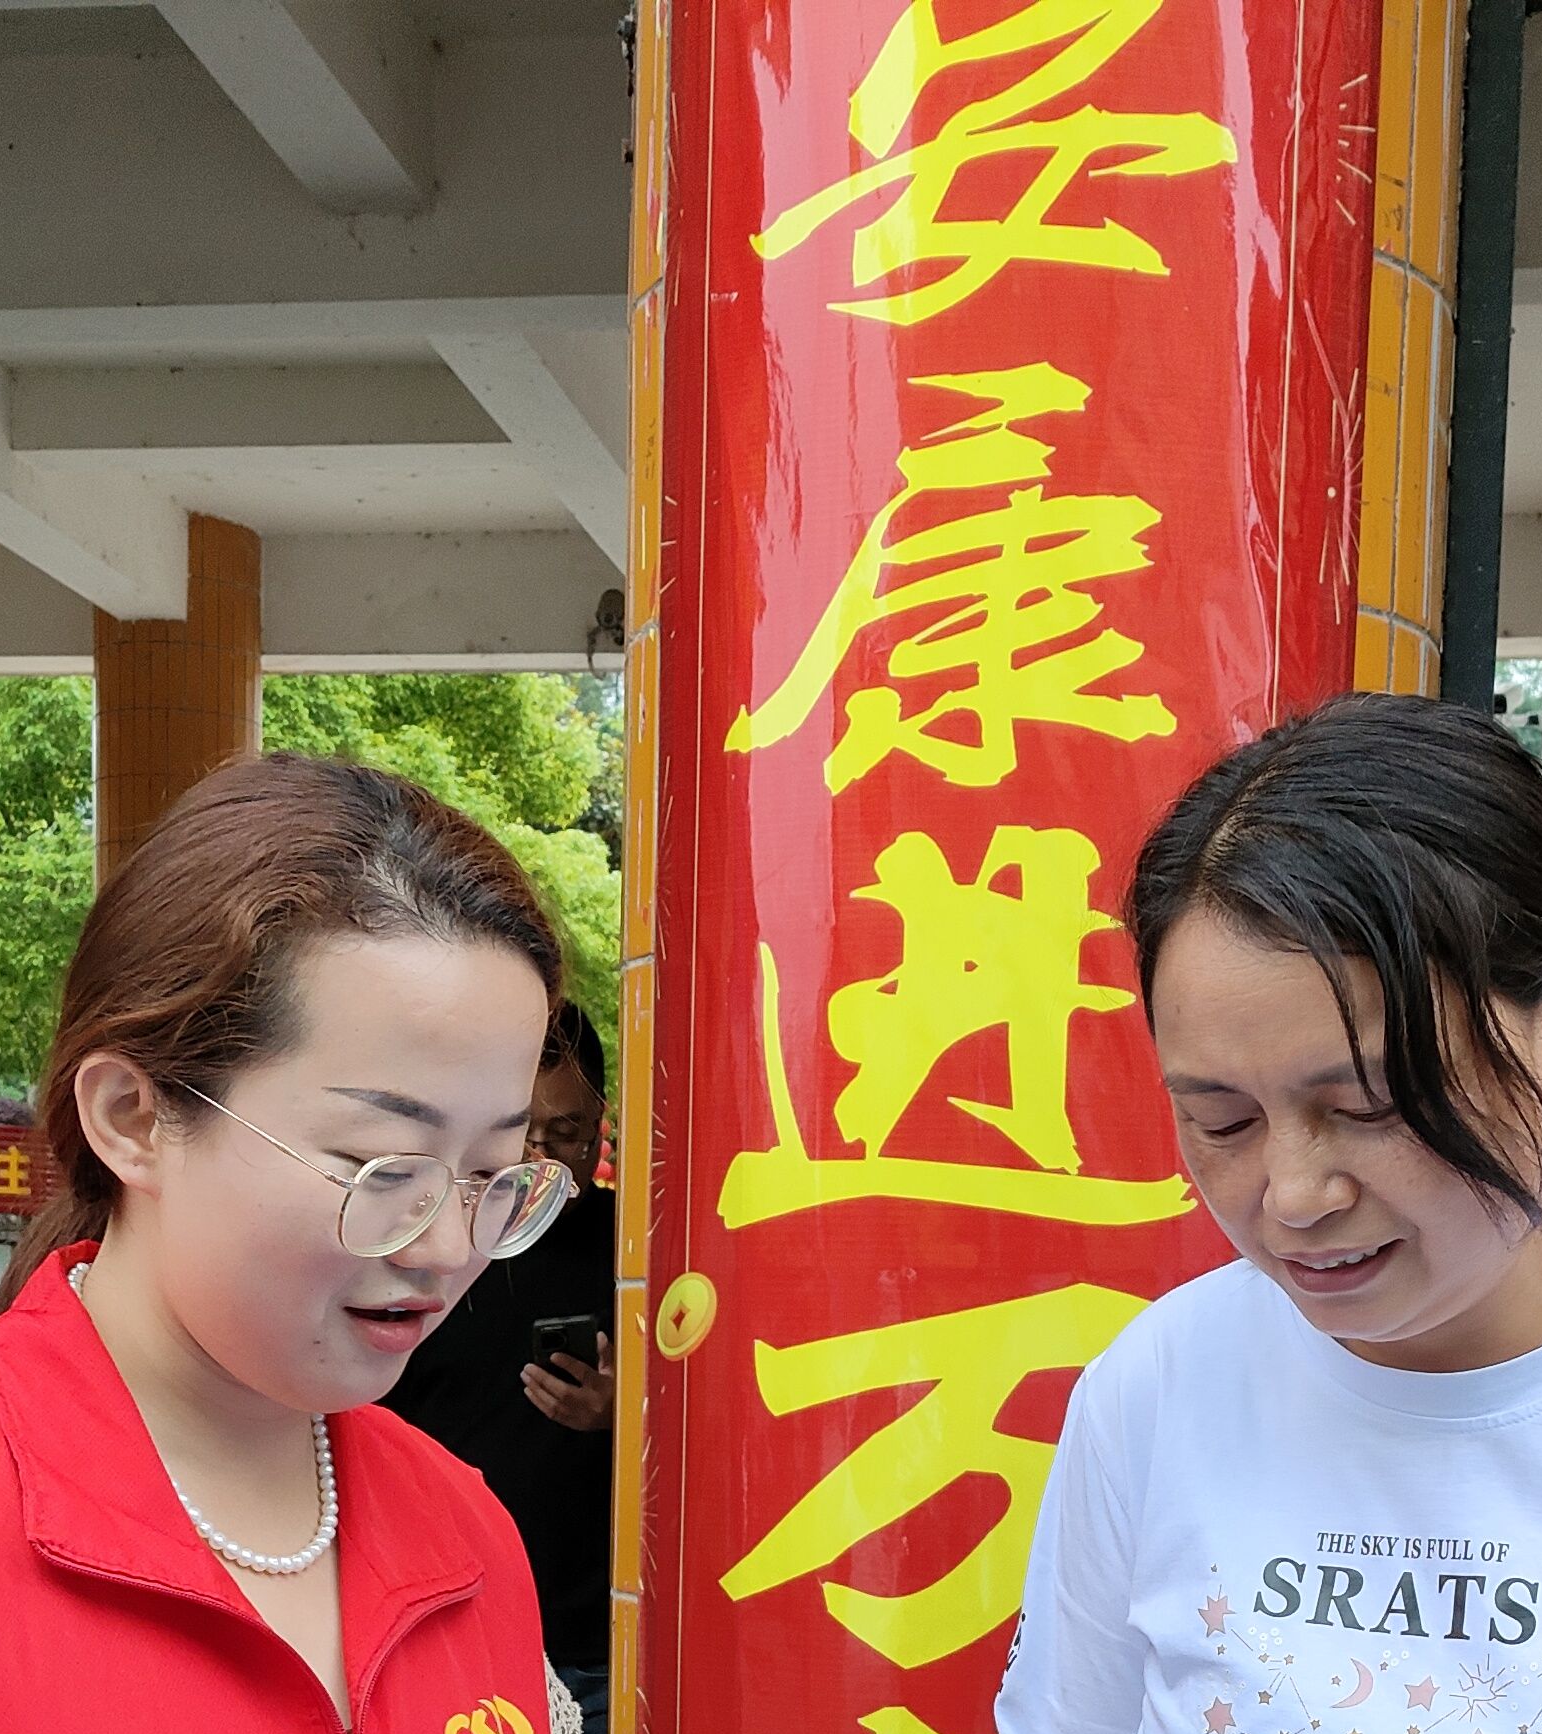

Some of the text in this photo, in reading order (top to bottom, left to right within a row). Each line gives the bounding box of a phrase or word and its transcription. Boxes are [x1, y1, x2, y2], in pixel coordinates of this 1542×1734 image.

[1316, 1532, 1511, 1563] THE SKY IS FULL OF
[1252, 1556, 1540, 1645] SRATS
